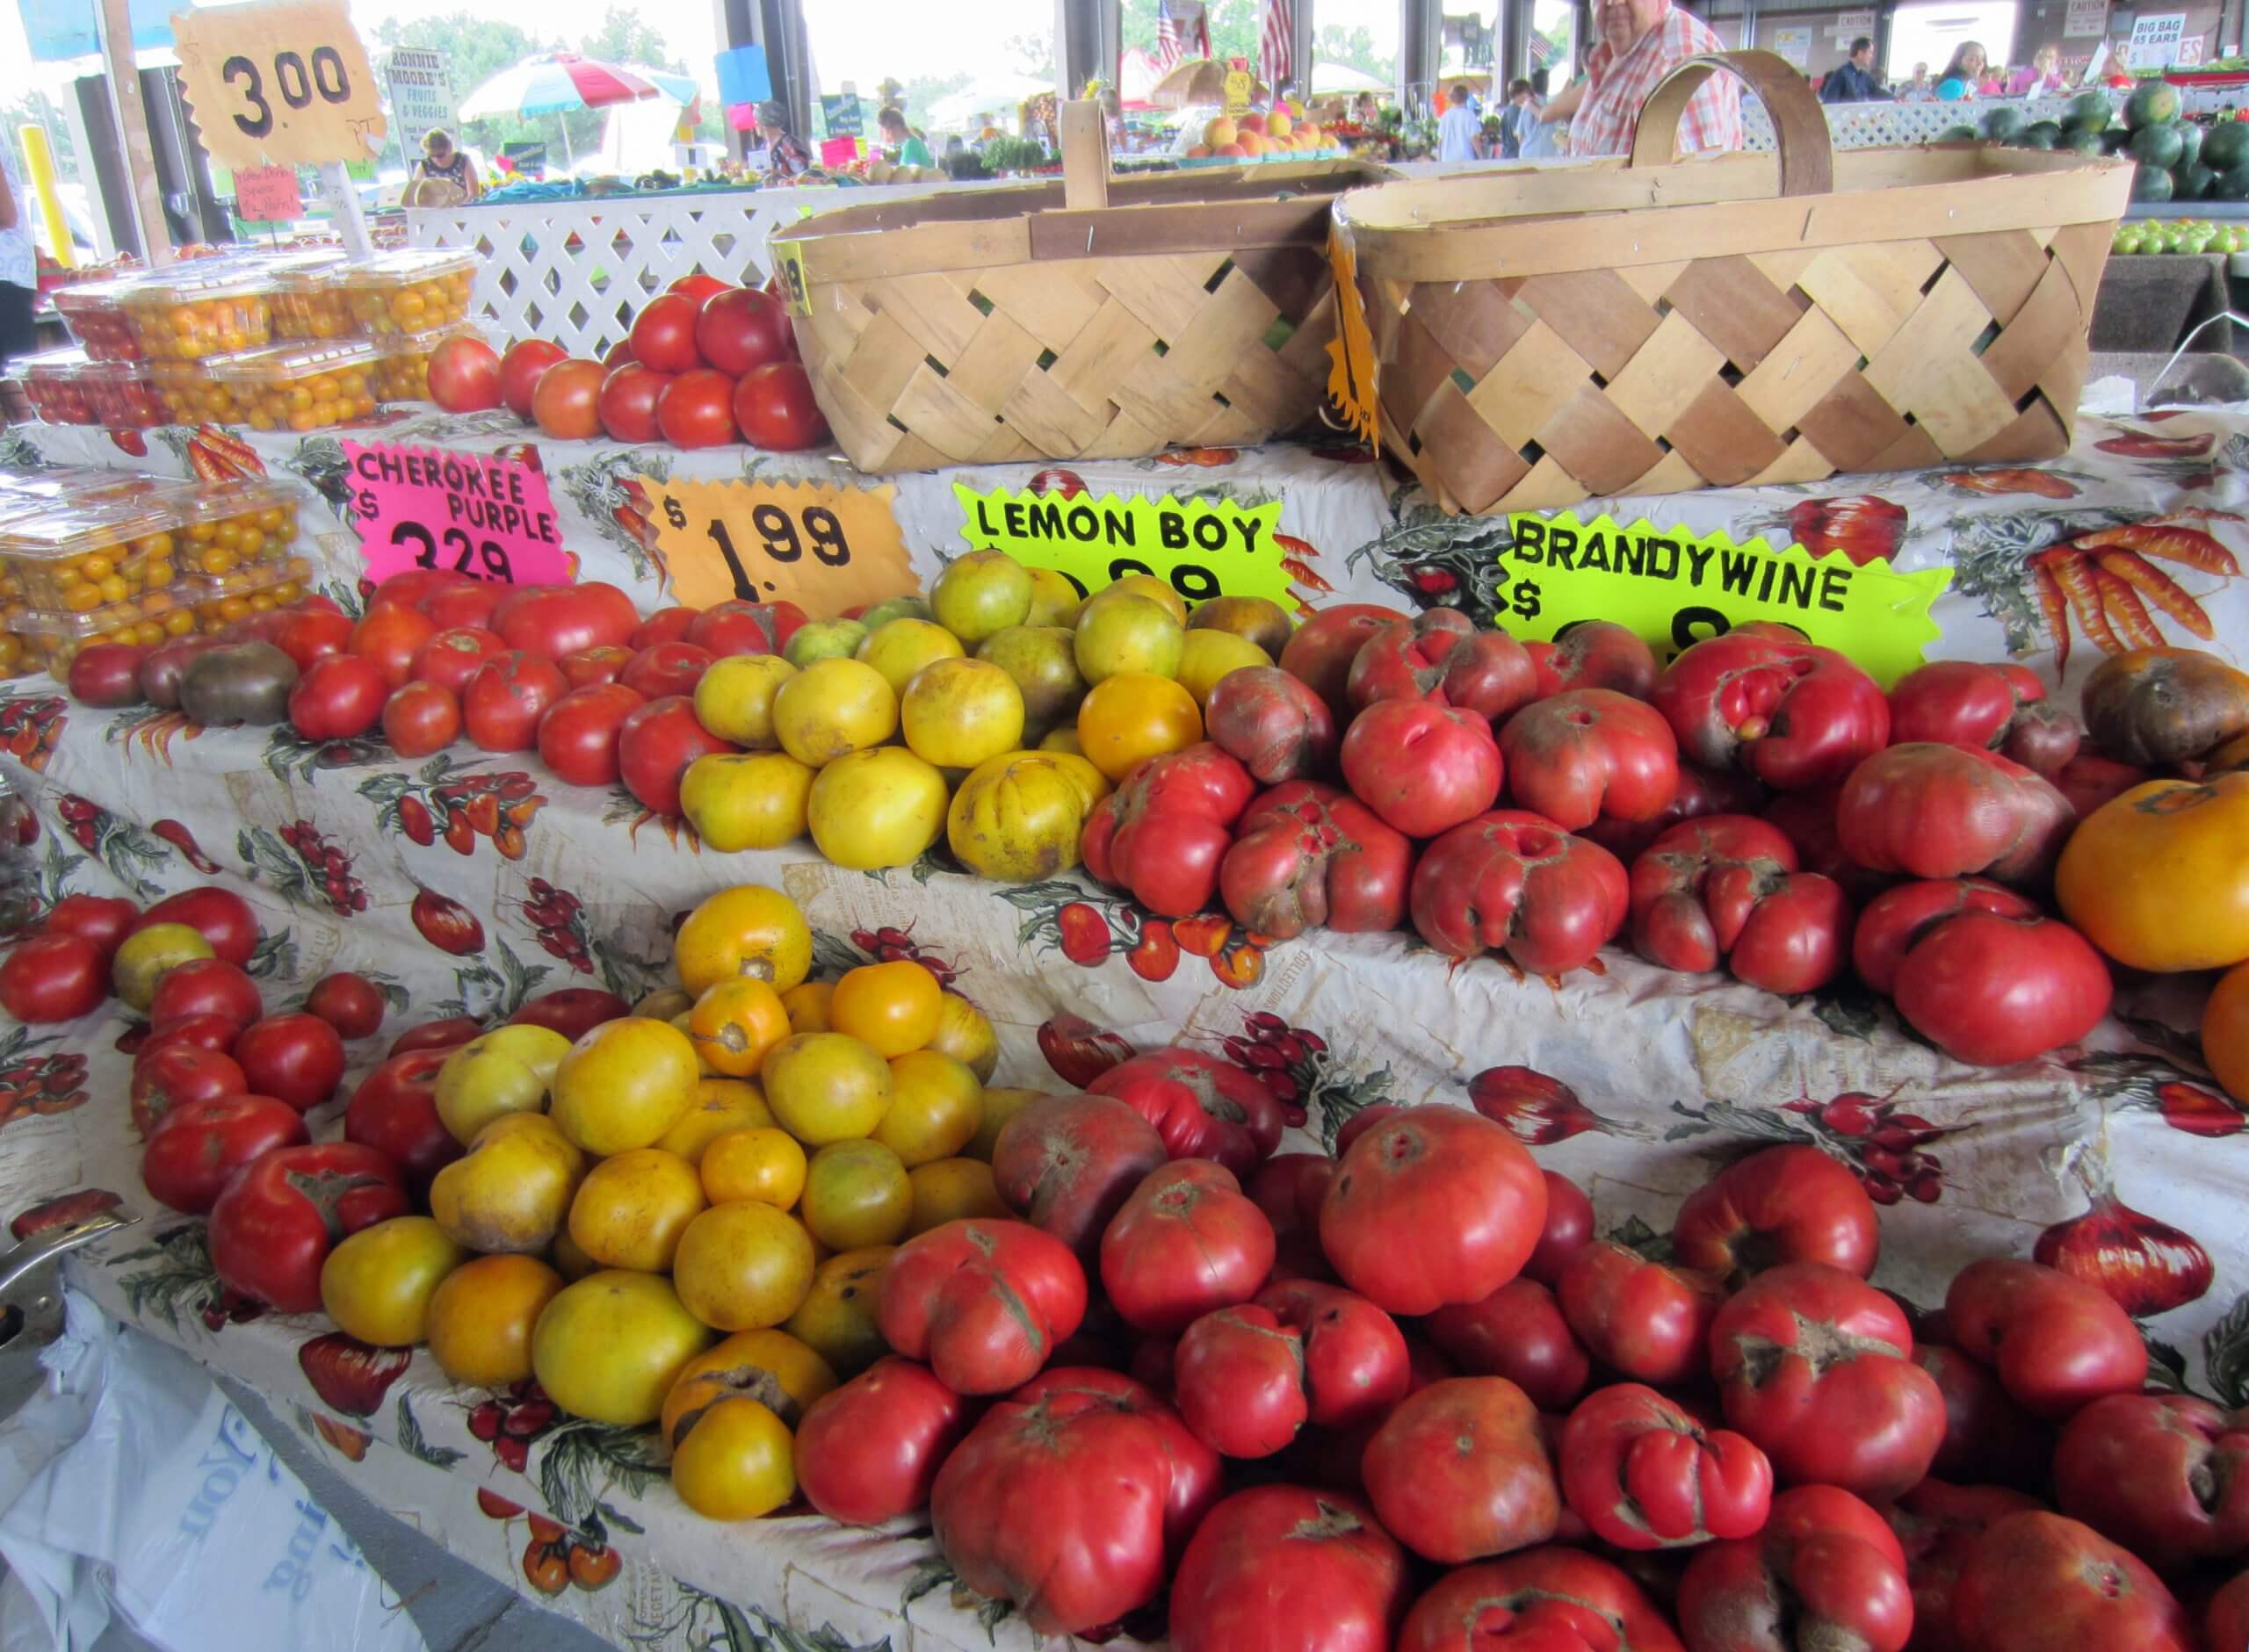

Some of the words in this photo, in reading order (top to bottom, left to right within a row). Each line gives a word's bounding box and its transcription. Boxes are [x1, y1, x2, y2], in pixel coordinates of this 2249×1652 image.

[2136, 22, 2155, 33] BIG
[2157, 20, 2180, 32] BAG
[2149, 33, 2179, 44] EARS
[392, 69, 447, 87] MOORE'S
[393, 51, 440, 69] RONNIE
[222, 47, 351, 139] 3.00
[407, 88, 437, 104] FRUITS
[412, 106, 448, 119] VEGGIES
[357, 451, 525, 506] CHEROKEE
[358, 487, 380, 522] $
[446, 492, 556, 545] PURPLE
[976, 499, 1136, 547] LEMON
[1159, 510, 1262, 553] BOY
[662, 494, 688, 531] $
[706, 503, 852, 604] 1.99
[1513, 519, 1853, 612] BRANDYWINE
[1512, 578, 1542, 622] $
